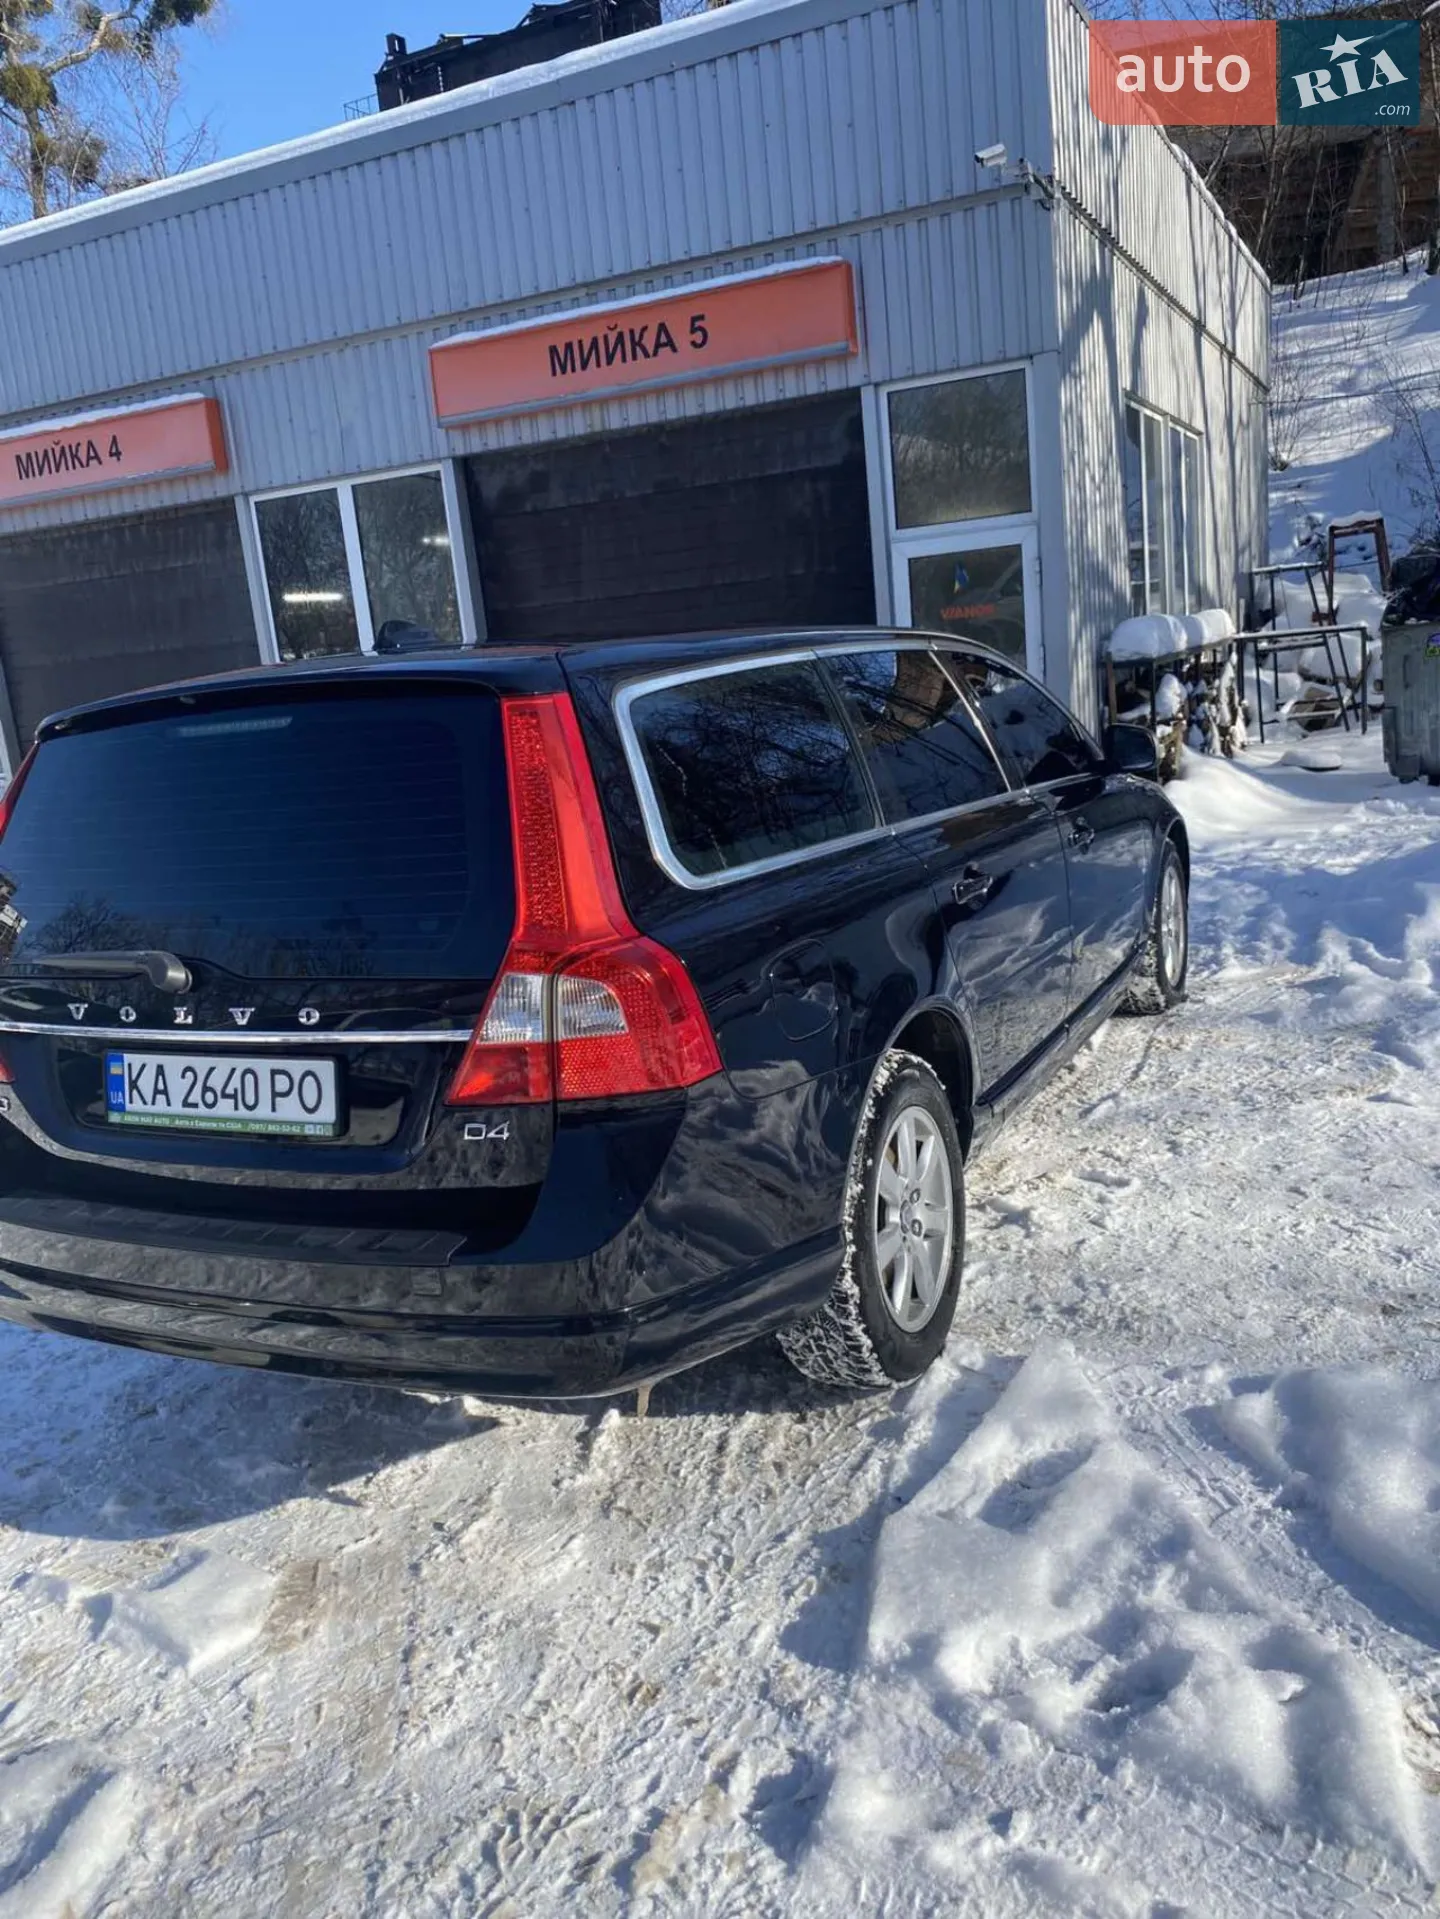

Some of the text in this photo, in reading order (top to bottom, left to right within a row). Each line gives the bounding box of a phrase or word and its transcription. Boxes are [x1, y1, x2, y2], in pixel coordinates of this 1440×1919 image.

[548, 314, 709, 377] МИЙКА 5
[15, 434, 123, 480] МИЙКА 4
[67, 1003, 321, 1026] VOLVO
[110, 1091, 125, 1105] UA
[127, 1062, 171, 1107] KA
[181, 1065, 259, 1112] 2640
[464, 1120, 510, 1140] D4
